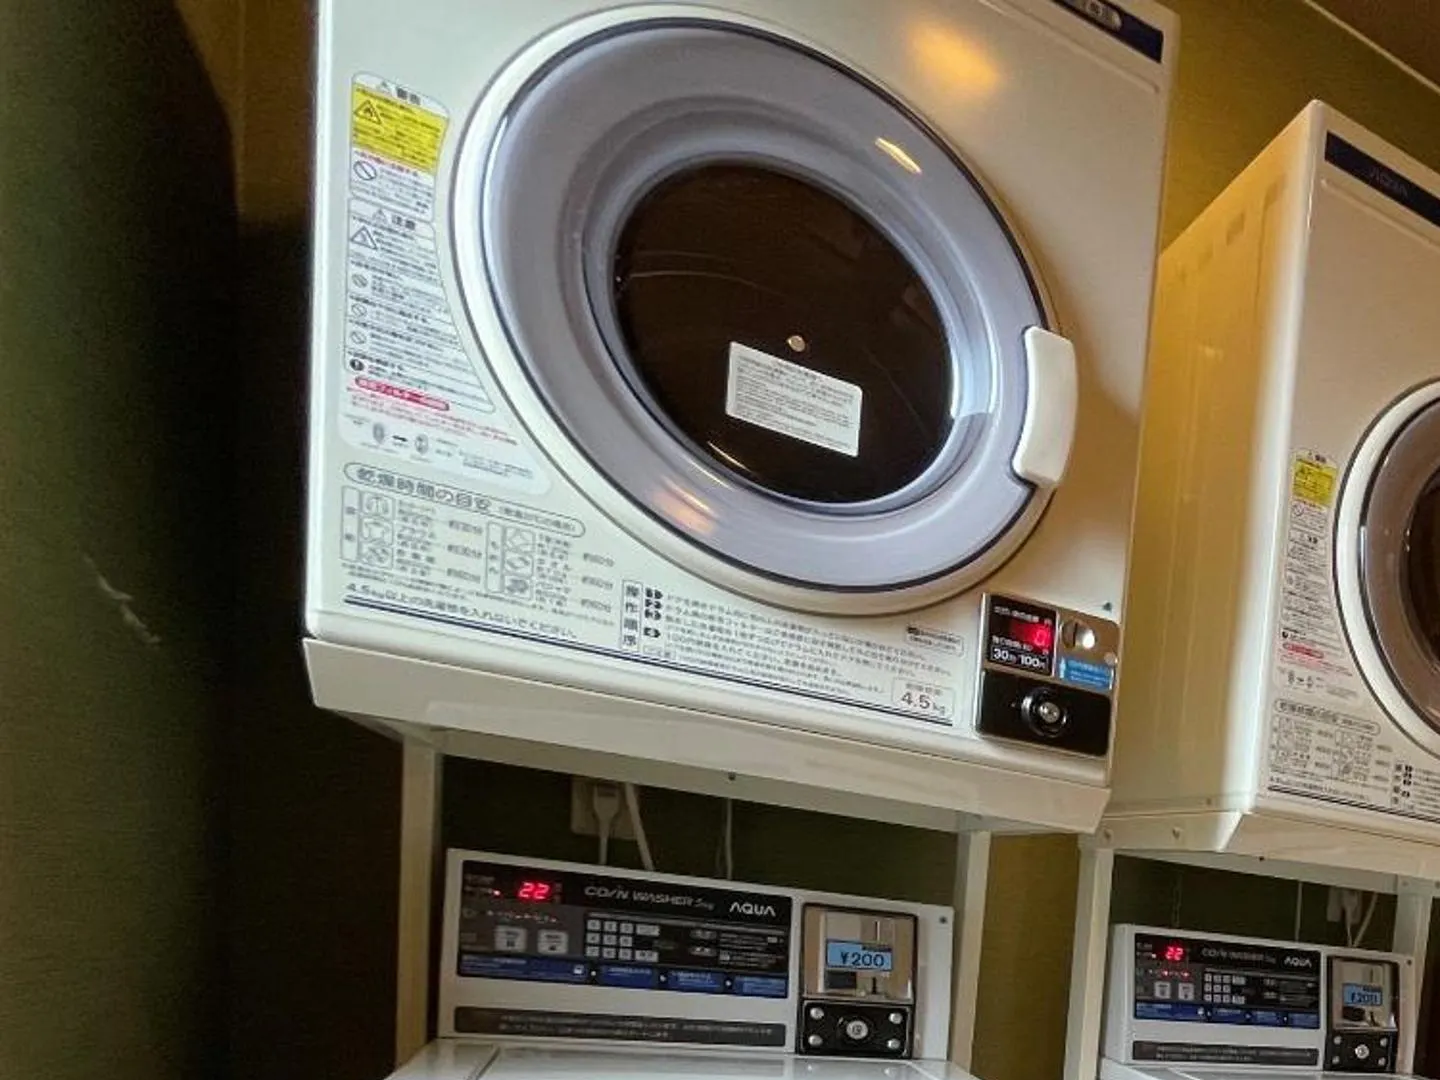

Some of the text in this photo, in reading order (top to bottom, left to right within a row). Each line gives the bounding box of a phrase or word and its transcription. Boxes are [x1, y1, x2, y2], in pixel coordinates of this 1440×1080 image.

[517, 881, 551, 900] 22
[632, 891, 693, 907] WASHER
[729, 901, 778, 918] AQUA
[840, 950, 886, 968] ¥200
[1165, 946, 1185, 961] 22
[1284, 955, 1313, 969] AQUA
